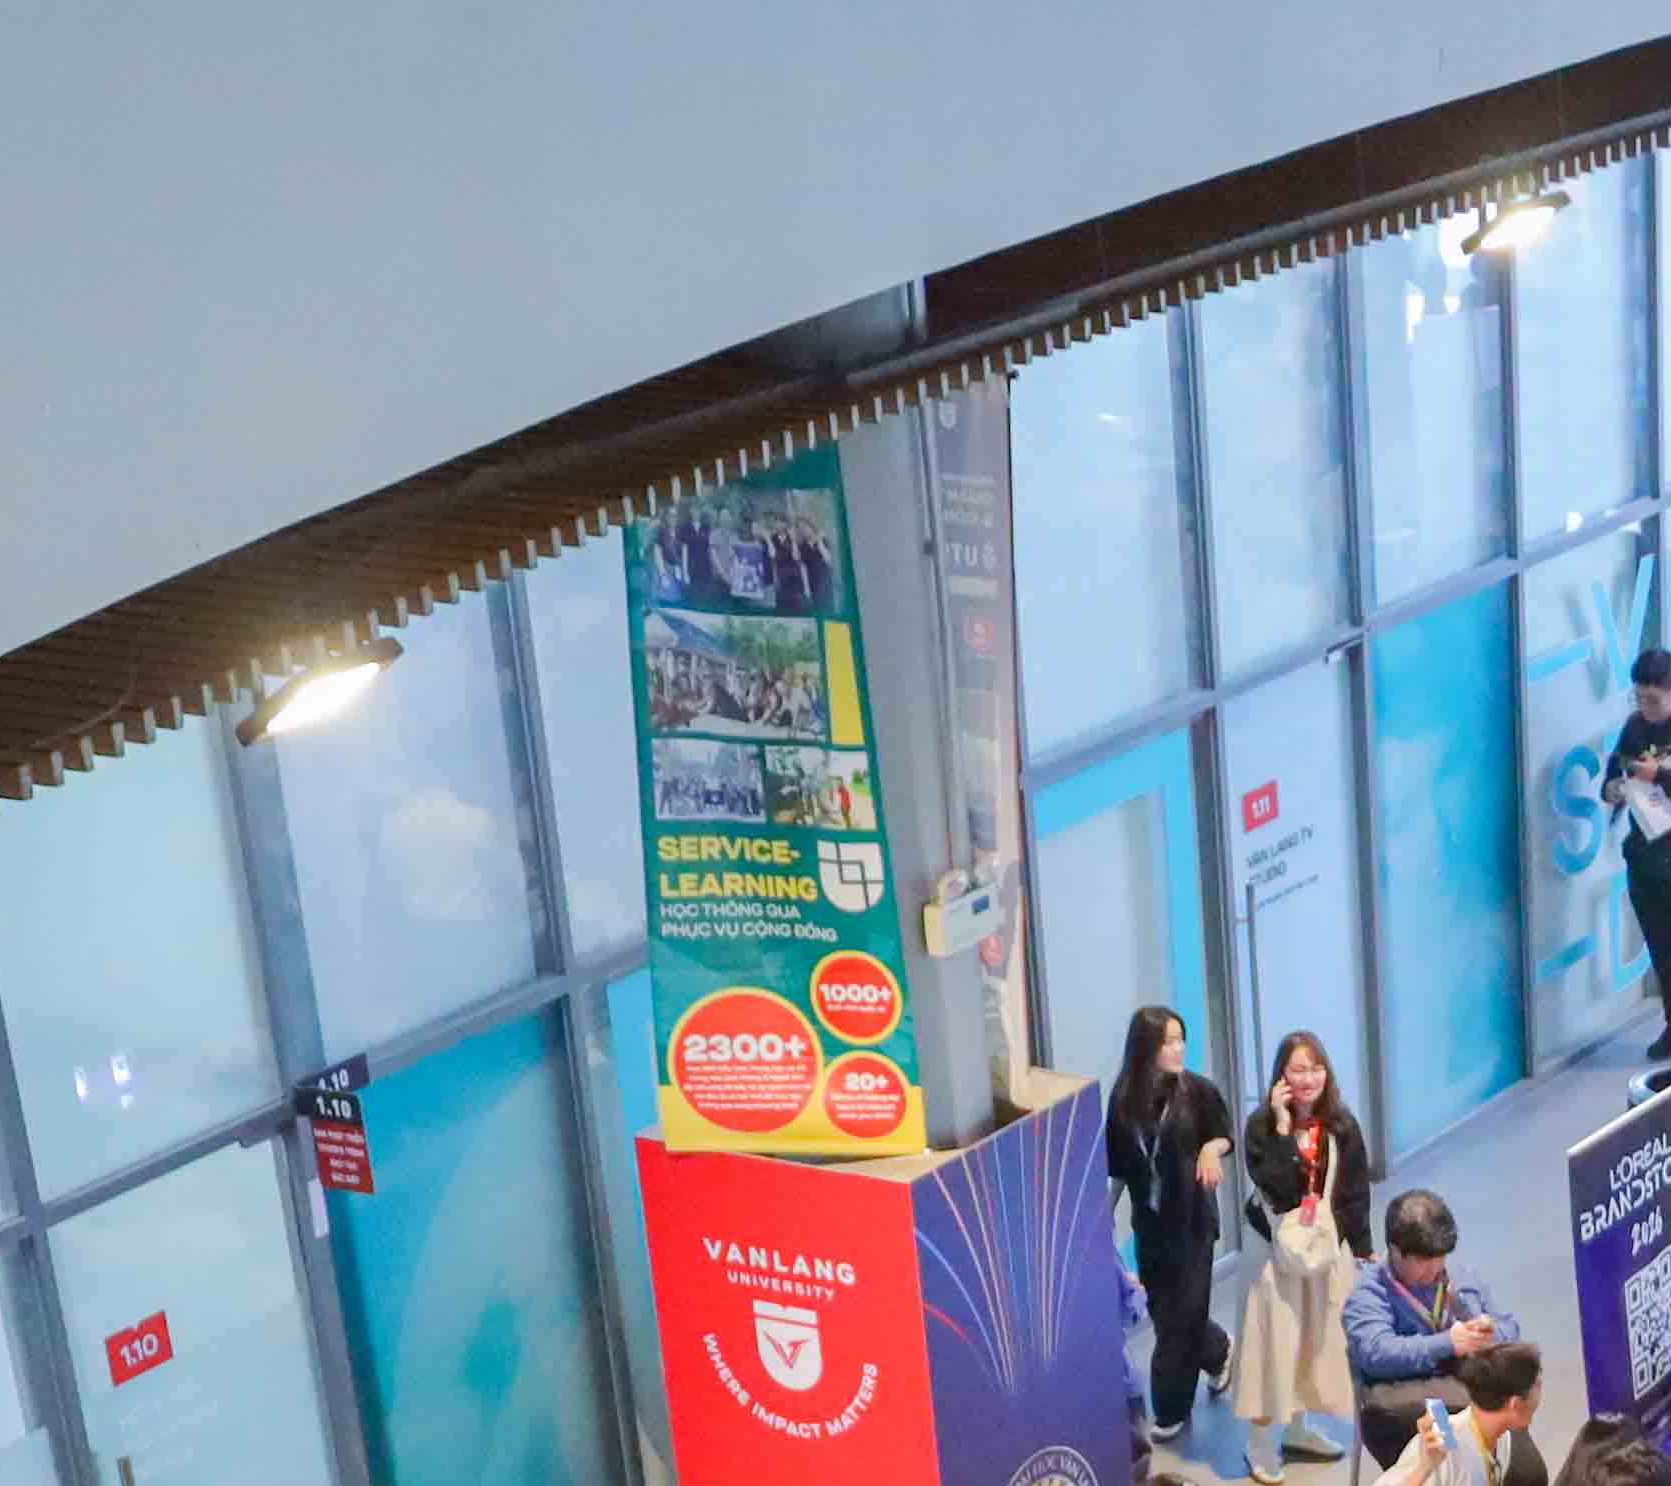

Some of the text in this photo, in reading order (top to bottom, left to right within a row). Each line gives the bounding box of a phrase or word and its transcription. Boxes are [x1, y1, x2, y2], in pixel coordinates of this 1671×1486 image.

[657, 835, 801, 864] SERVICE-
[658, 873, 818, 900] LEARNING
[765, 904, 801, 919] QUA
[819, 983, 892, 1003] 1000+
[683, 1033, 806, 1062] 2300+
[844, 1072, 889, 1091] 20+
[316, 1095, 352, 1119] 1.10
[702, 1236, 857, 1287] VANLANG
[727, 1269, 836, 1301] UNIVERSITY
[118, 1331, 160, 1369] 1.10
[702, 1333, 879, 1440] WHERE IMPACT MATTERS
